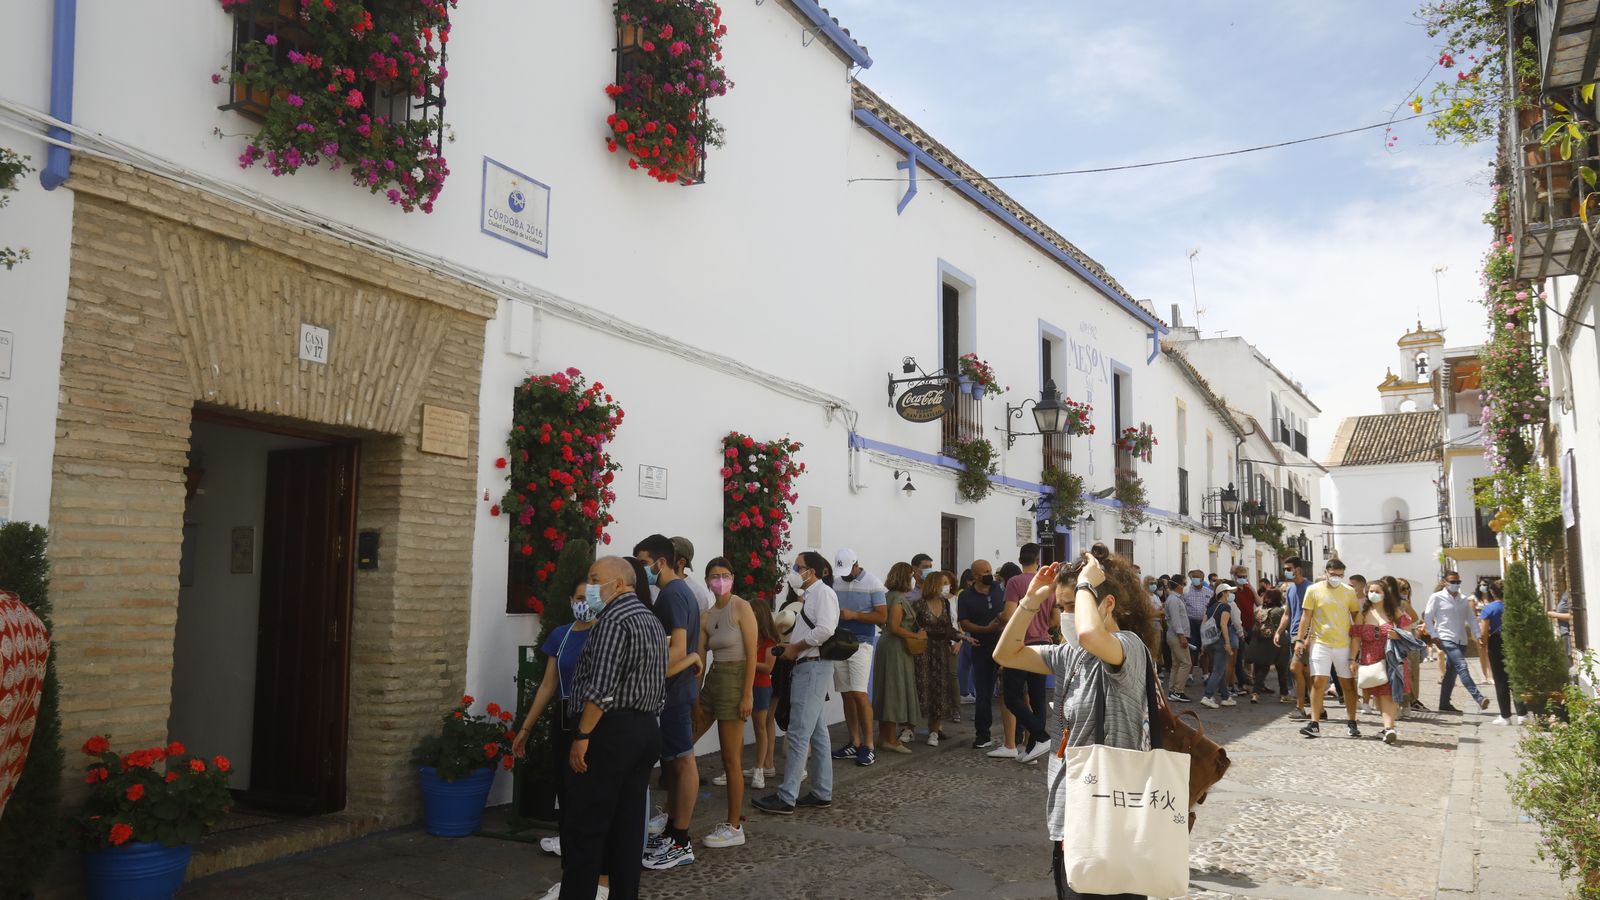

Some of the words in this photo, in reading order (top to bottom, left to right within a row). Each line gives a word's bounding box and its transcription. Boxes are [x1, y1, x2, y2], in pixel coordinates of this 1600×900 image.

[488, 208, 524, 230] CÓRDOBA
[526, 223, 543, 238] 2016
[305, 331, 324, 347] CASA
[313, 345, 323, 359] 17
[901, 389, 946, 408] Coca-Cola
[1092, 789, 1176, 812] 一日三秋
